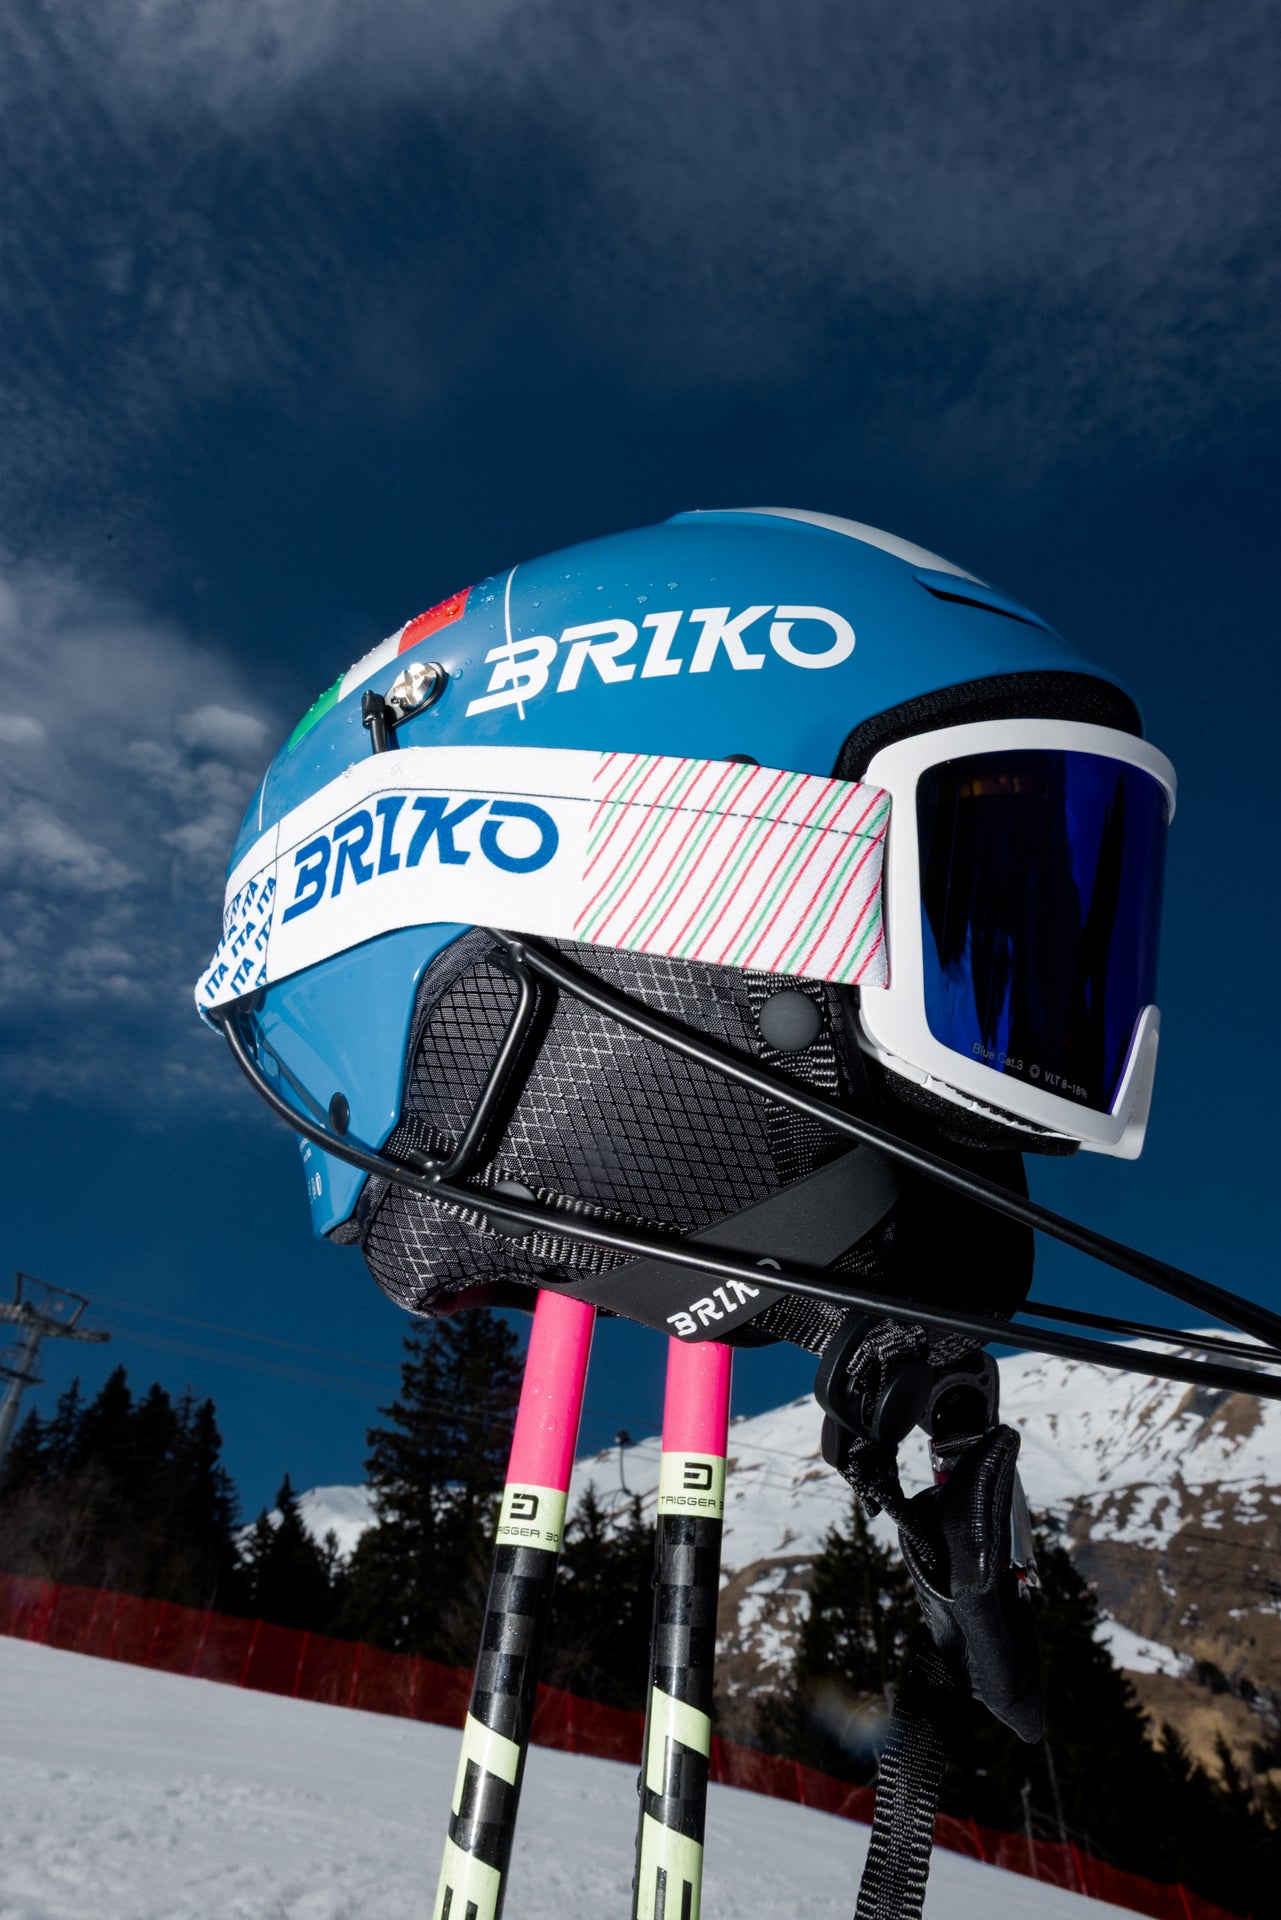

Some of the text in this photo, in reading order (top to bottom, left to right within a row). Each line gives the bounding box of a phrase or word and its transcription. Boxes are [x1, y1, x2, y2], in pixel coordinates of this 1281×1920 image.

[466, 605, 856, 717] BRIKO
[282, 796, 559, 924] BRIKO
[231, 921, 256, 958] ITA
[204, 962, 229, 1000] ITA
[230, 957, 255, 996] ITA
[972, 1042, 995, 1060] Blue
[998, 1052, 1024, 1071] Cat.3
[1044, 1070, 1062, 1087] VLT
[666, 1258, 782, 1336] BRIK
